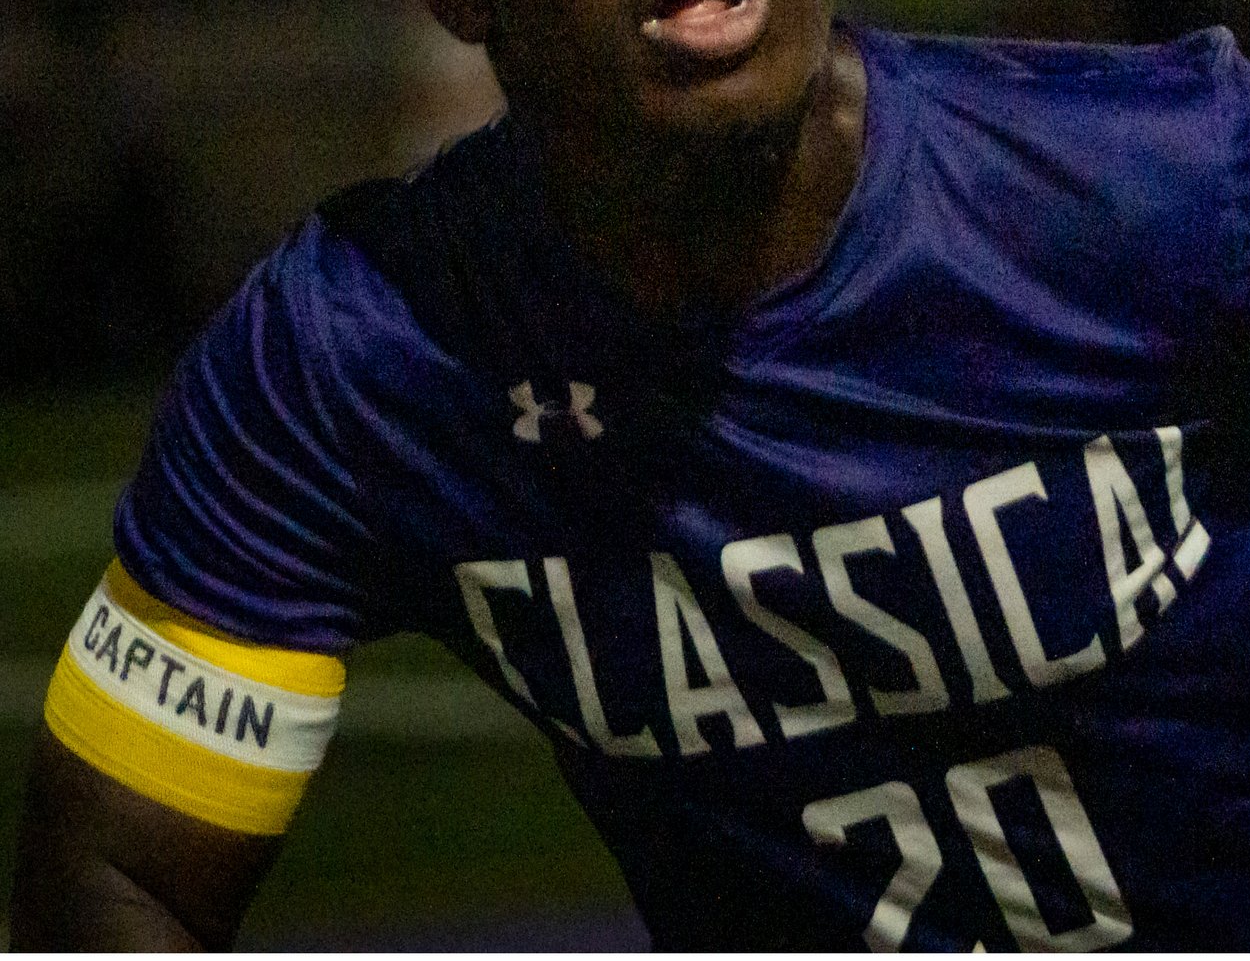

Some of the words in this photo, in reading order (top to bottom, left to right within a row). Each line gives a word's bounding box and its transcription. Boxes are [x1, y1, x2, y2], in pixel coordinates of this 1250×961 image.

[83, 603, 275, 749] CAPTAIN
[454, 425, 1212, 758] CLASSICAL
[802, 745, 1133, 953] 20
